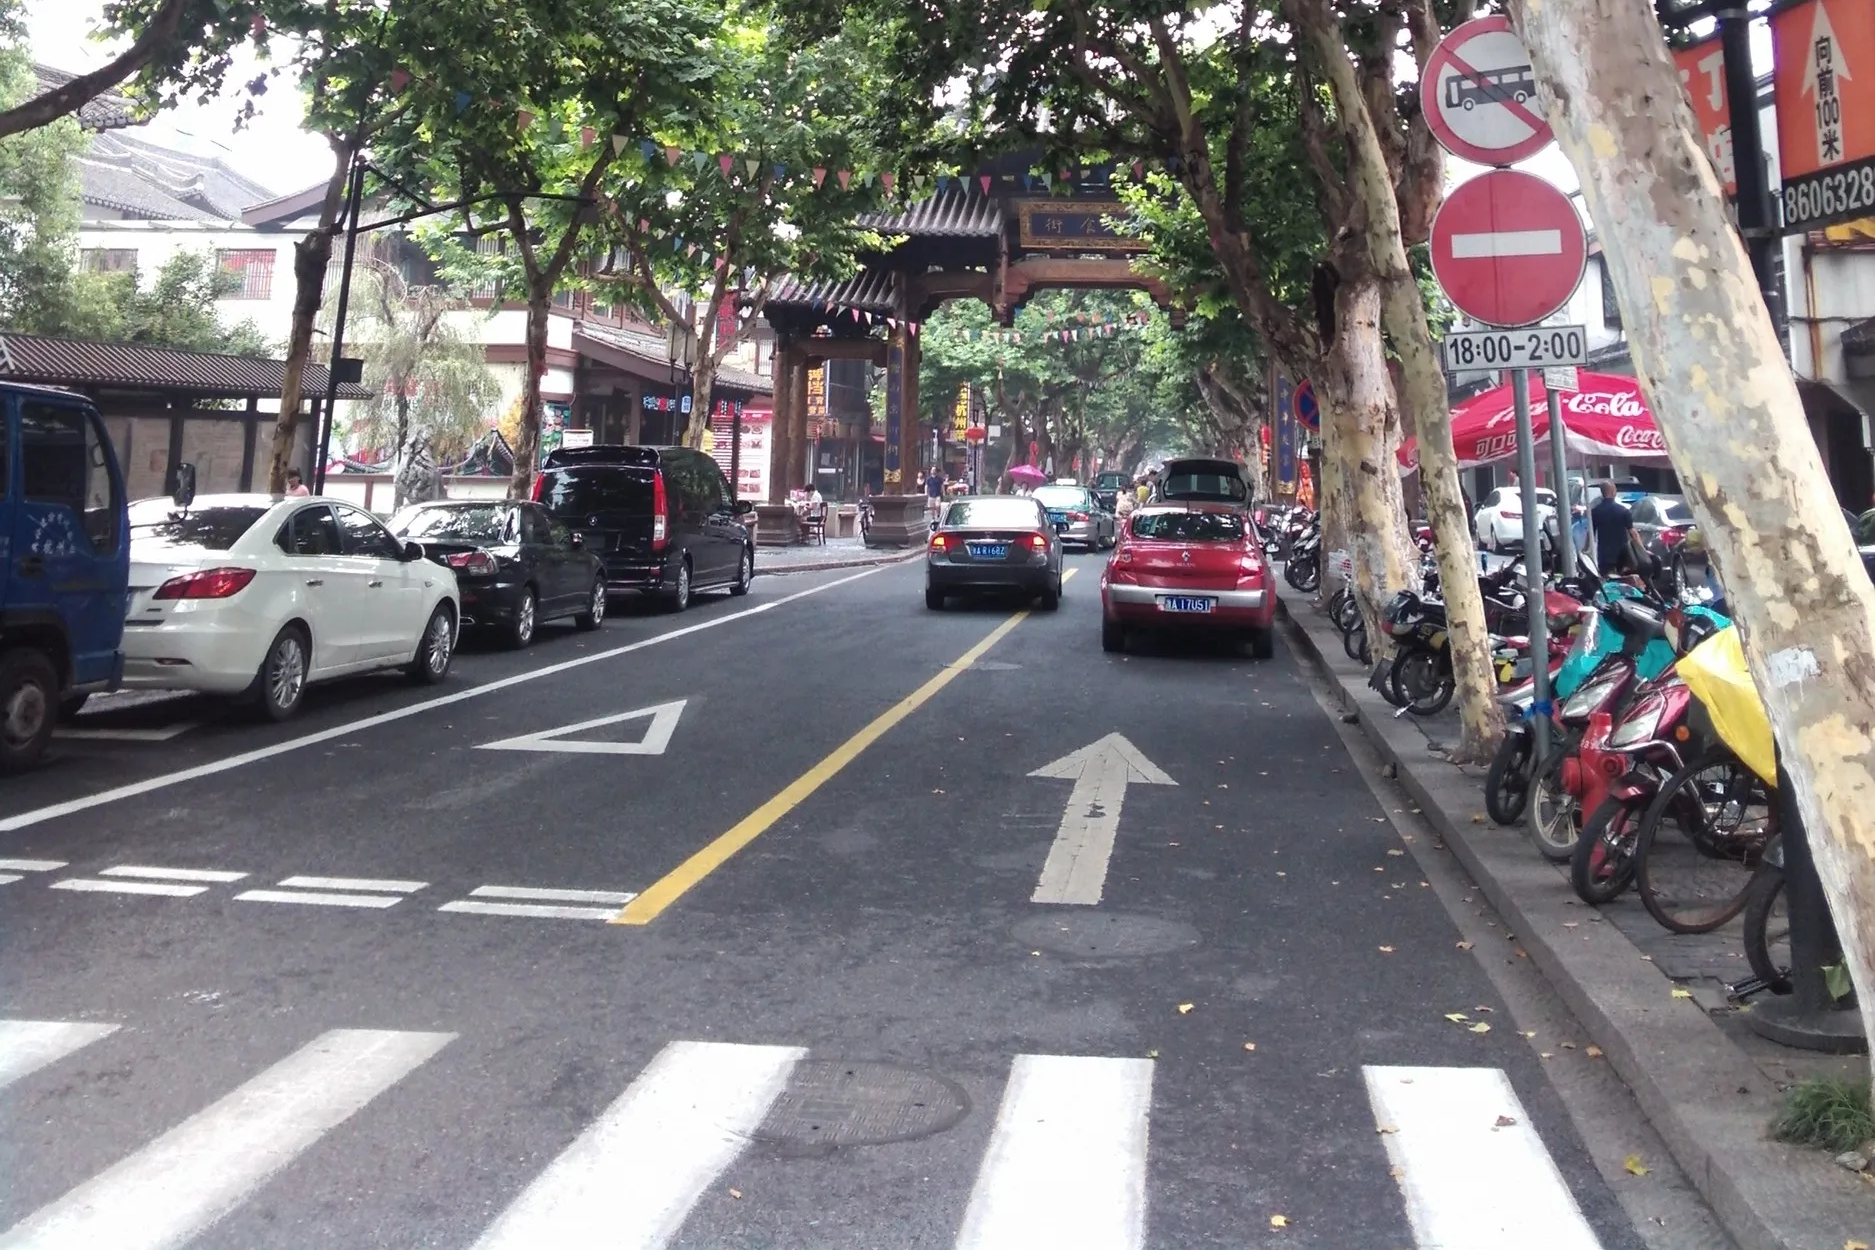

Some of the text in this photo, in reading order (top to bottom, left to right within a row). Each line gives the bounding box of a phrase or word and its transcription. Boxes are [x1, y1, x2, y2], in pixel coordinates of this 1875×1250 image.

[1815, 35, 1840, 162] 向前100米
[1786, 166, 1875, 223] 8606328
[1451, 331, 1581, 364] 18:00-2:00
